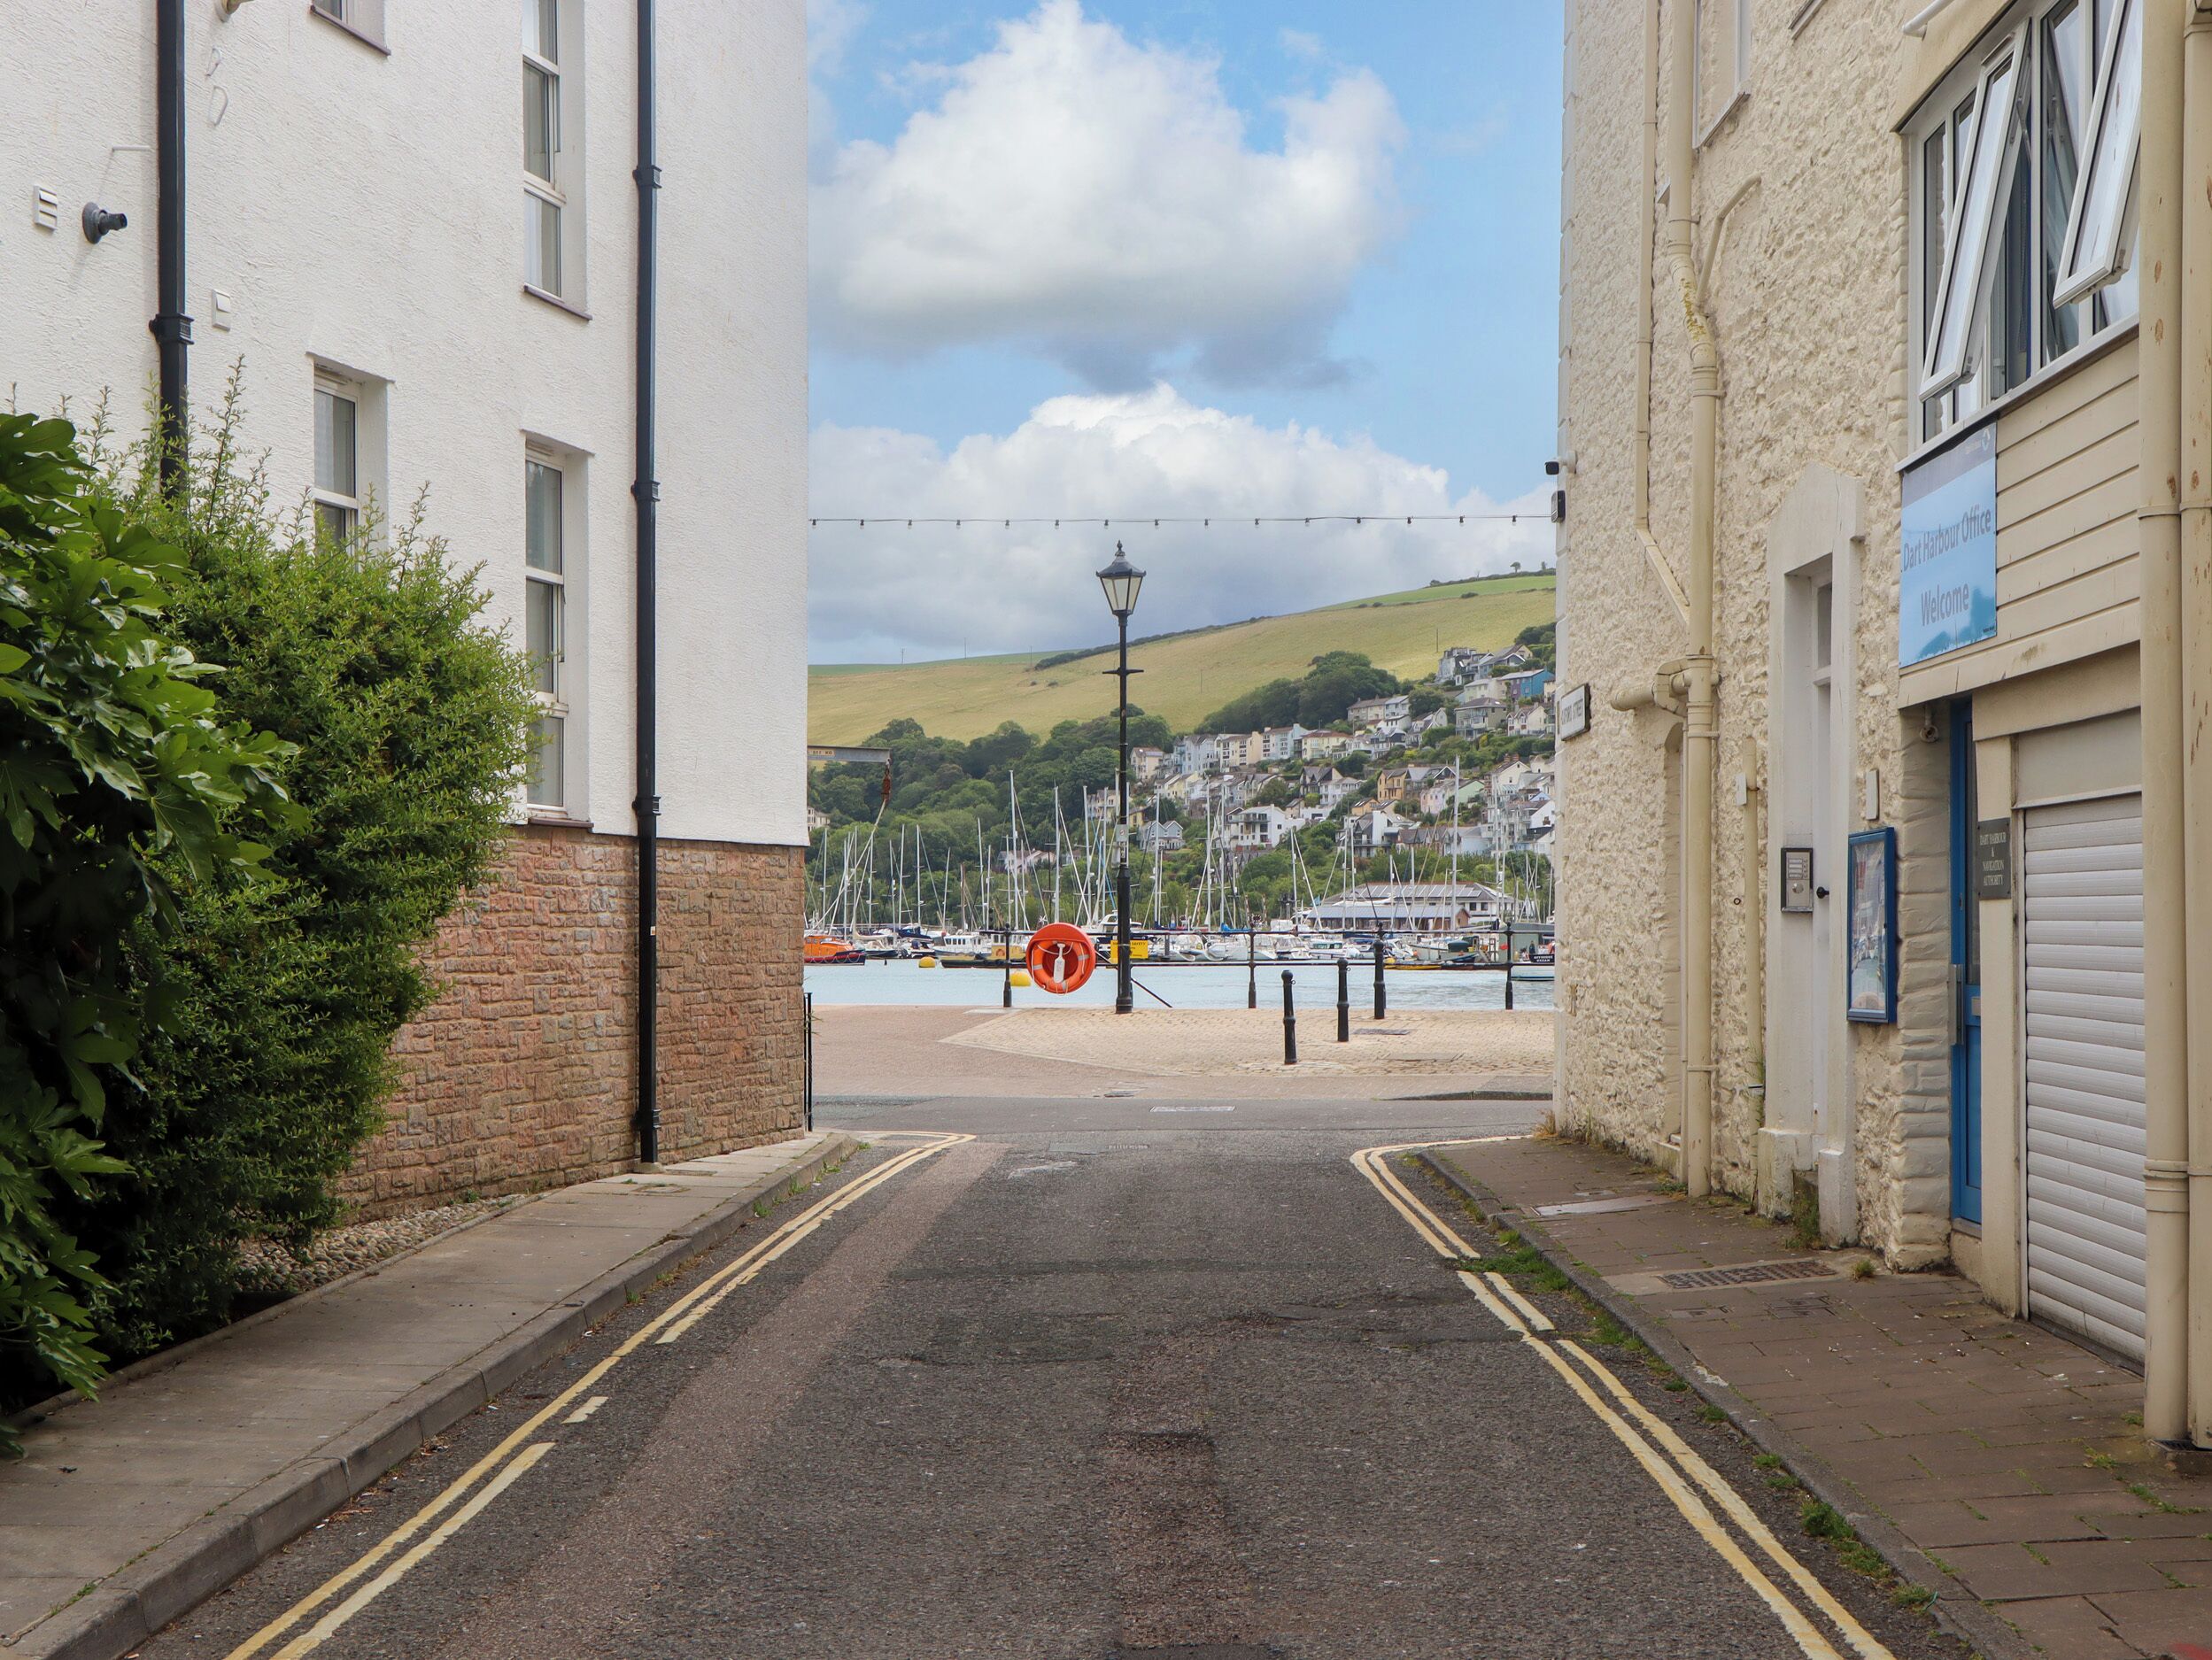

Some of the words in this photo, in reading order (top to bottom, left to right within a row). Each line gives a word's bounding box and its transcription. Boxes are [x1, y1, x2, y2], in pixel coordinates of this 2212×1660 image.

[1904, 539, 1922, 572] Dart
[1923, 523, 1961, 563] Harbour
[1961, 504, 1992, 543] Office
[1922, 583, 1969, 627] Welcome
[1983, 860, 2005, 871] NAVIGATION
